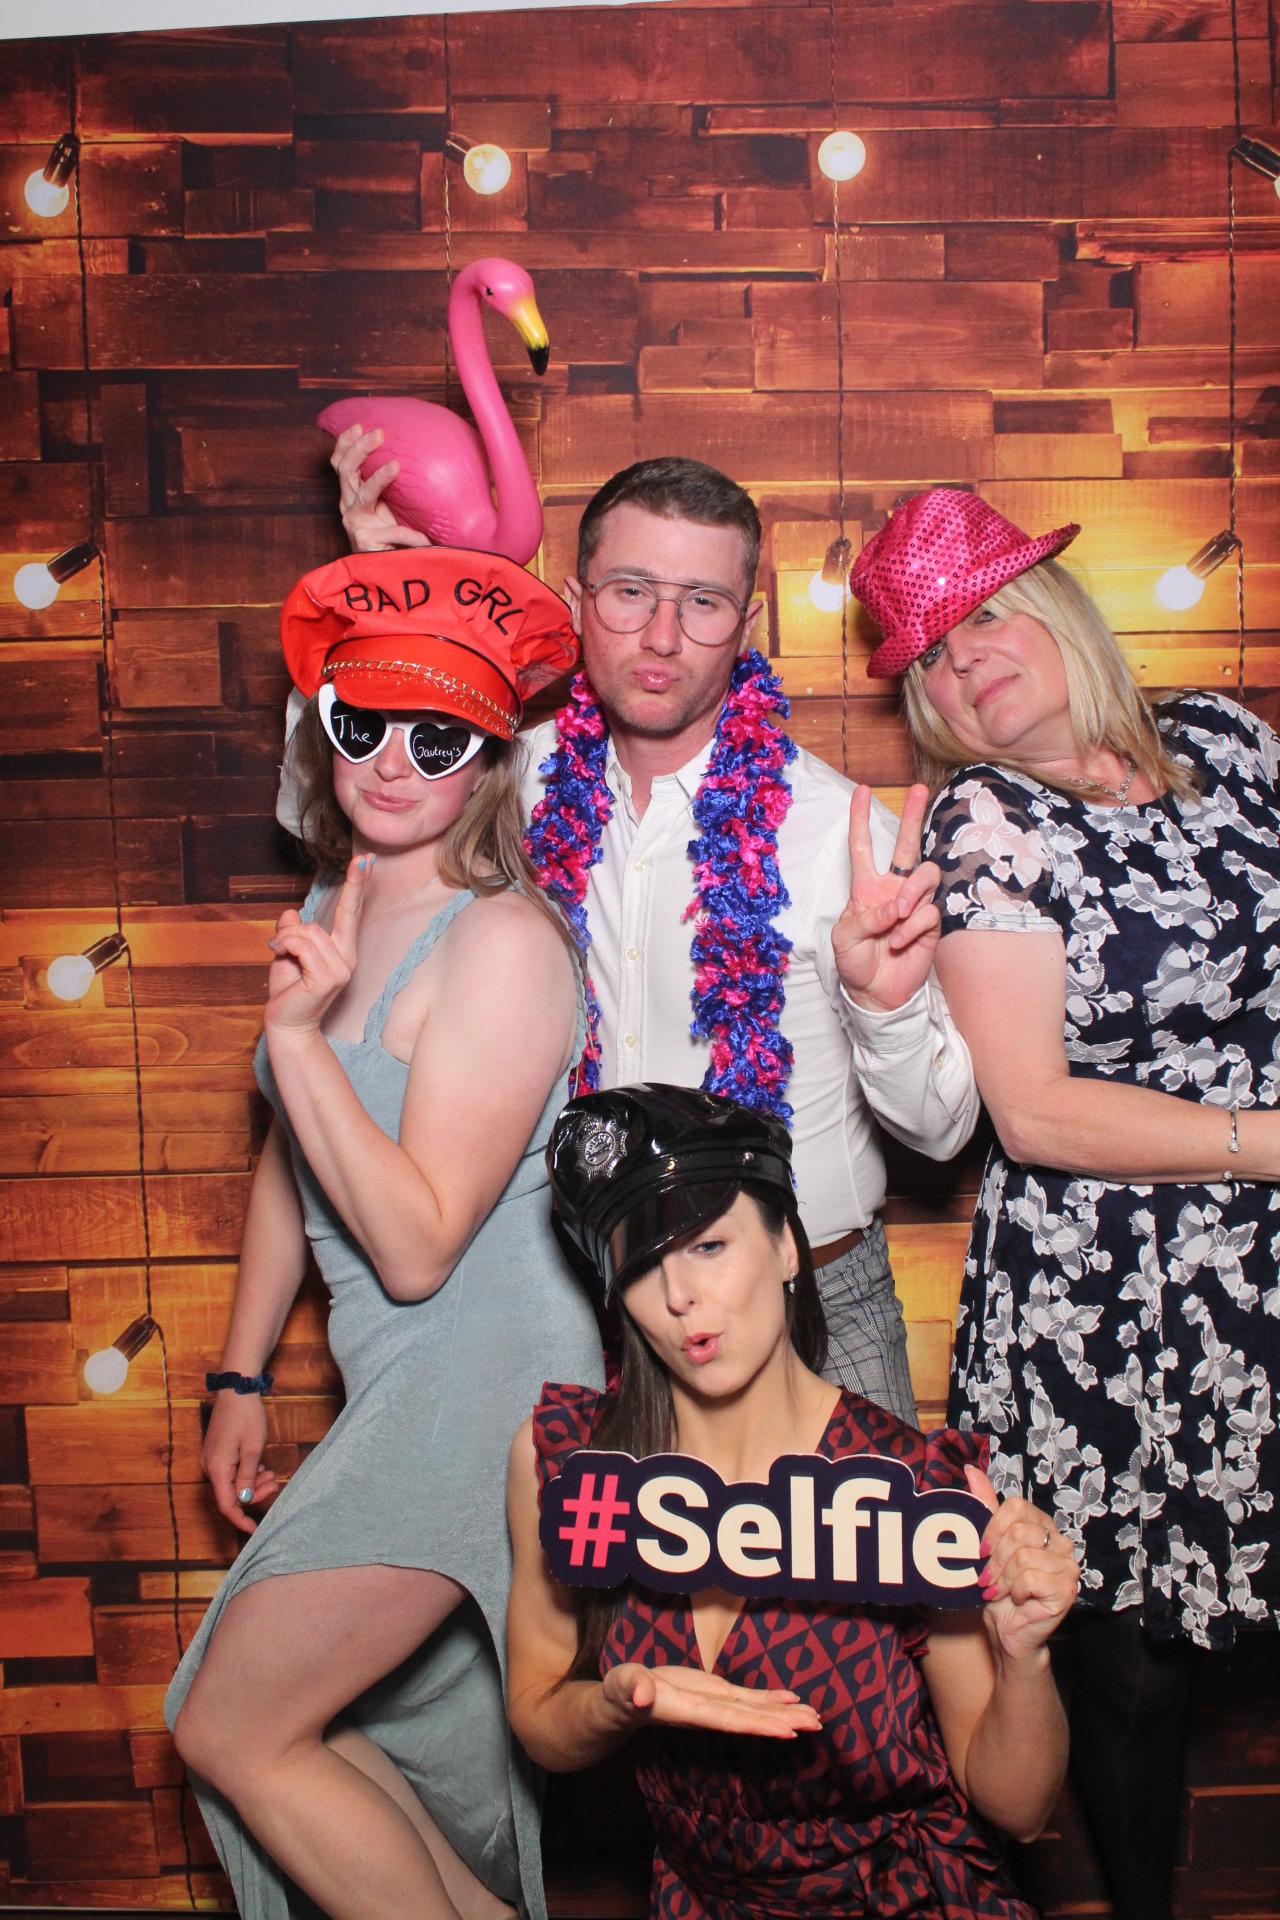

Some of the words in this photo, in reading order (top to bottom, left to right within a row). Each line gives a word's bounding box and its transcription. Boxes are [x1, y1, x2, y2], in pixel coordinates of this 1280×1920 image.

[344, 579, 430, 612] BAD
[454, 578, 524, 635] GRL
[333, 714, 373, 744] The
[413, 734, 462, 766] Gautrey's
[558, 1473, 981, 1588] #Selfie
